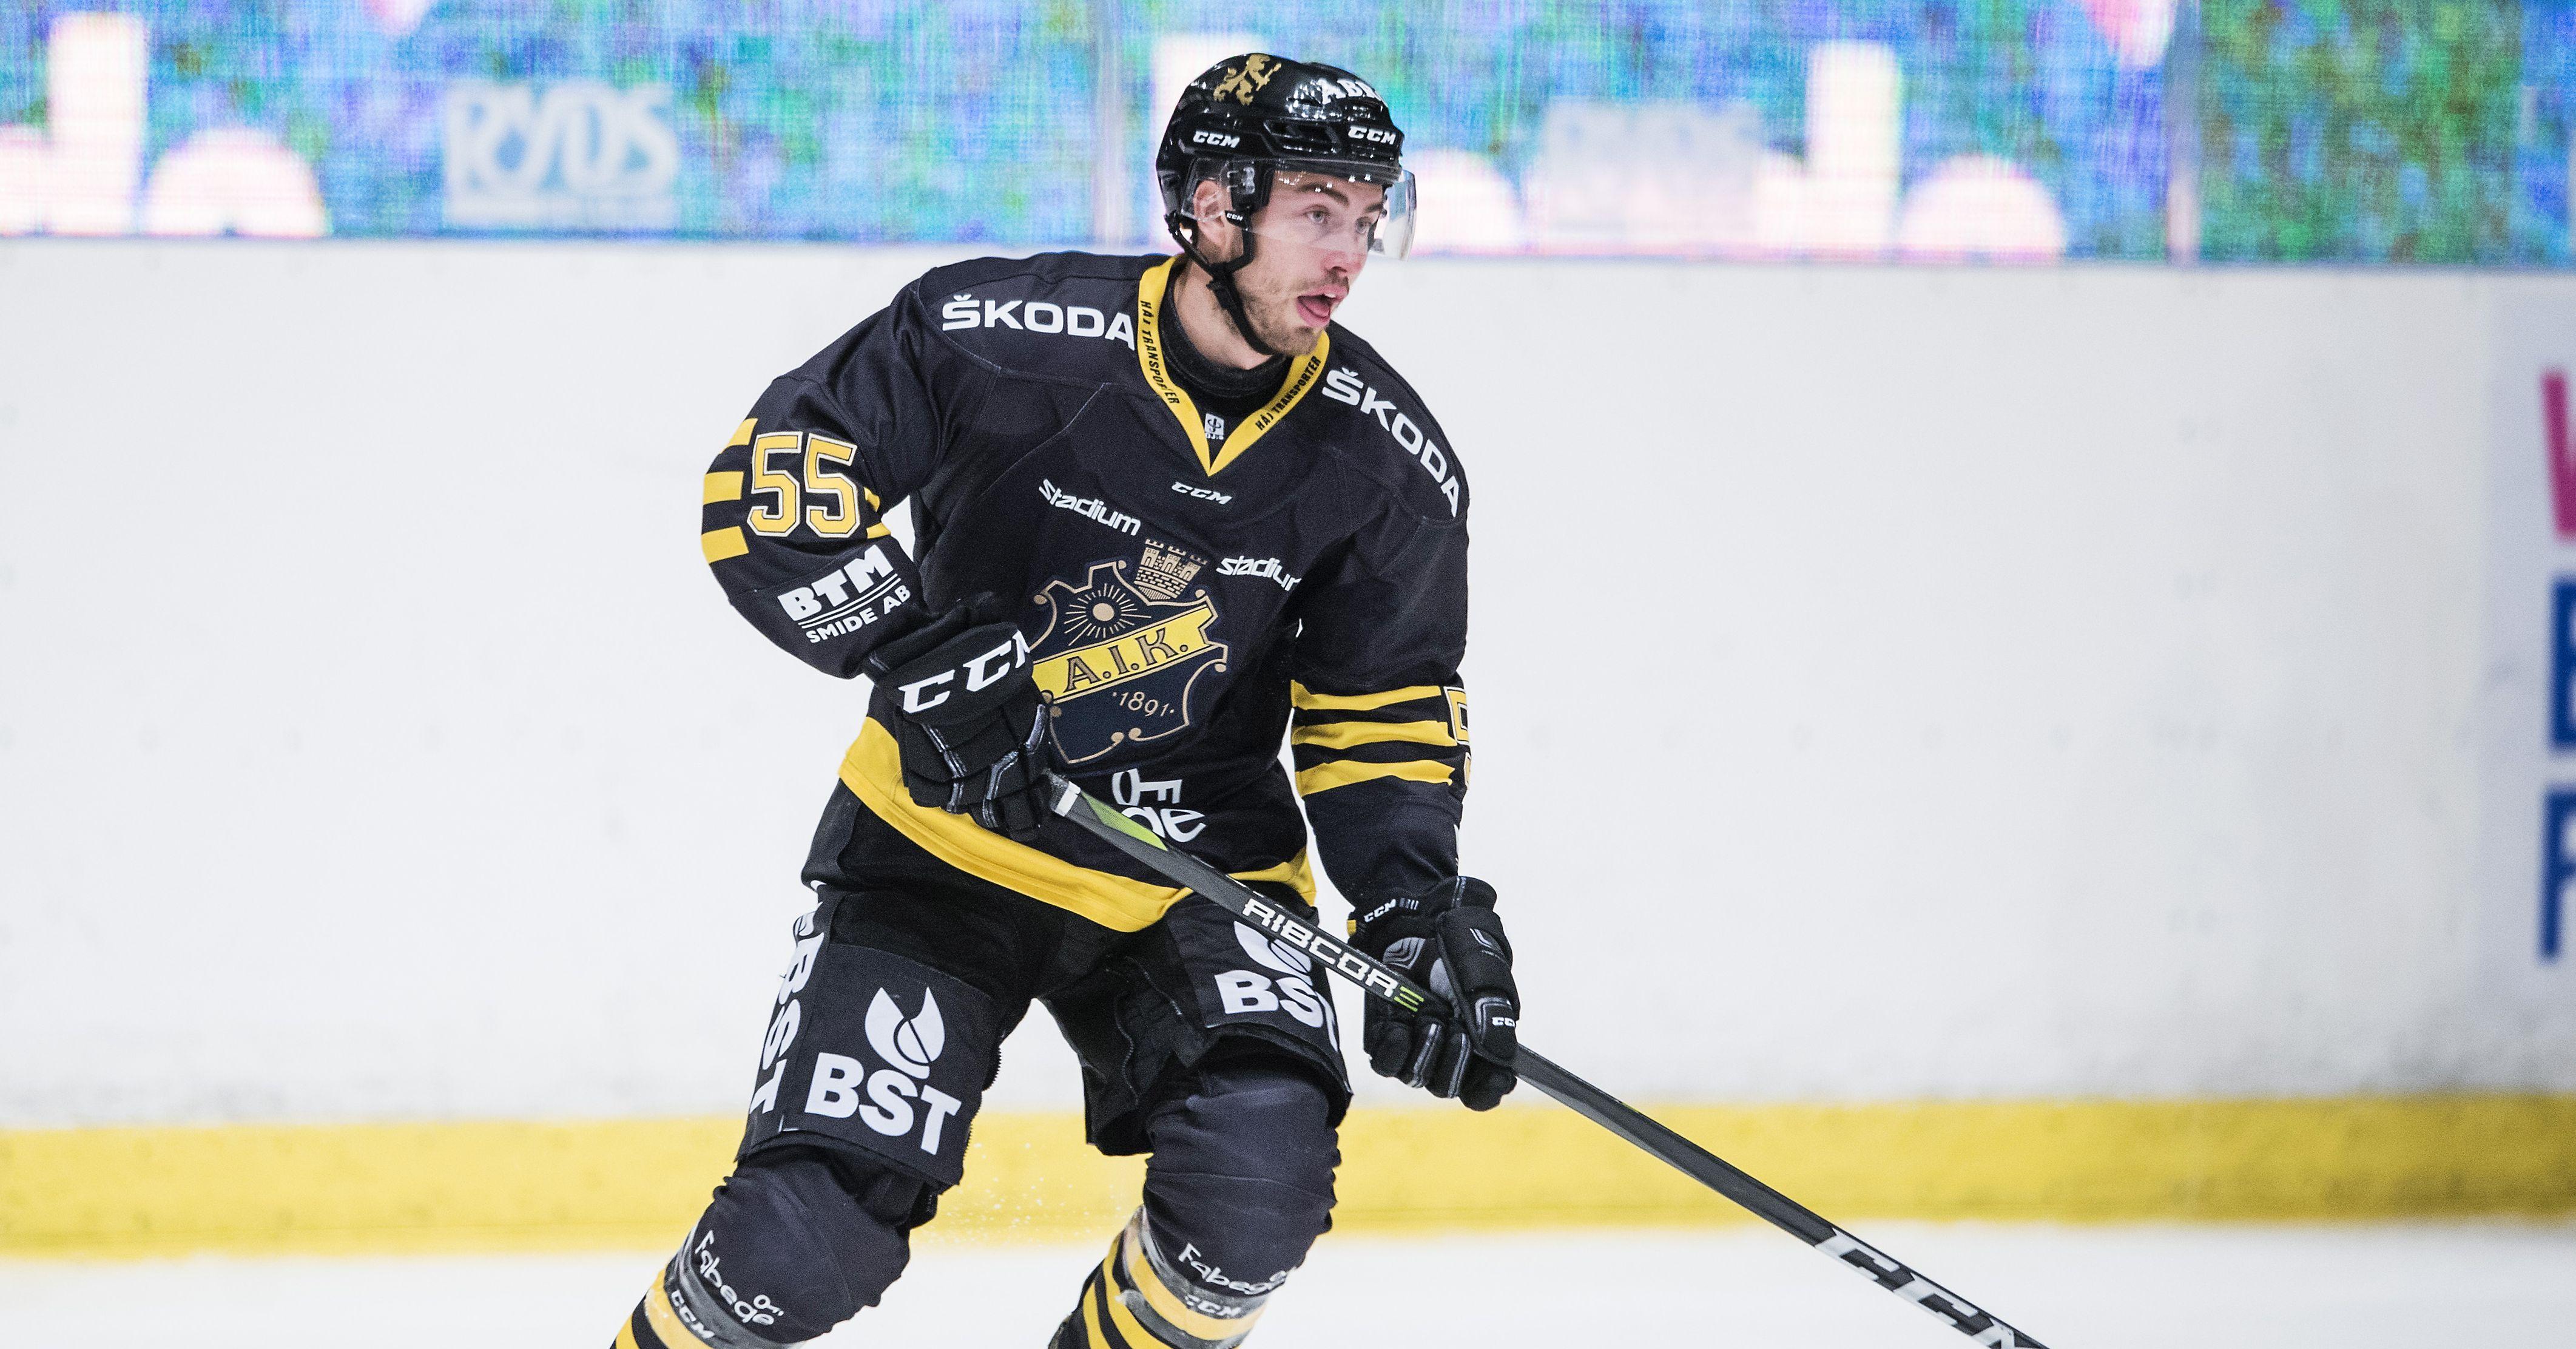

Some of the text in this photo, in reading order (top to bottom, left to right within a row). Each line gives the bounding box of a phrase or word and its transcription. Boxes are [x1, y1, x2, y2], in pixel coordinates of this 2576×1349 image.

[1193, 130, 1240, 148] CCM
[1347, 125, 1397, 146] CCM
[1226, 212, 1243, 221] CCM
[942, 294, 1135, 351] ŠKODA
[1271, 355, 1321, 413] TRANSPORTER
[1321, 367, 1459, 518] ŠKODA
[747, 431, 860, 538] 55
[1172, 481, 1232, 505] CCM
[777, 544, 894, 621] BTM
[806, 585, 911, 643] SMIDE AB
[1063, 627, 1189, 693] A.I.K.
[1364, 899, 1397, 922] CCM
[1242, 898, 1425, 1012] RIBCORE
[750, 932, 825, 1115] BST
[804, 1052, 962, 1155] BST
[671, 1289, 715, 1339] CCM
